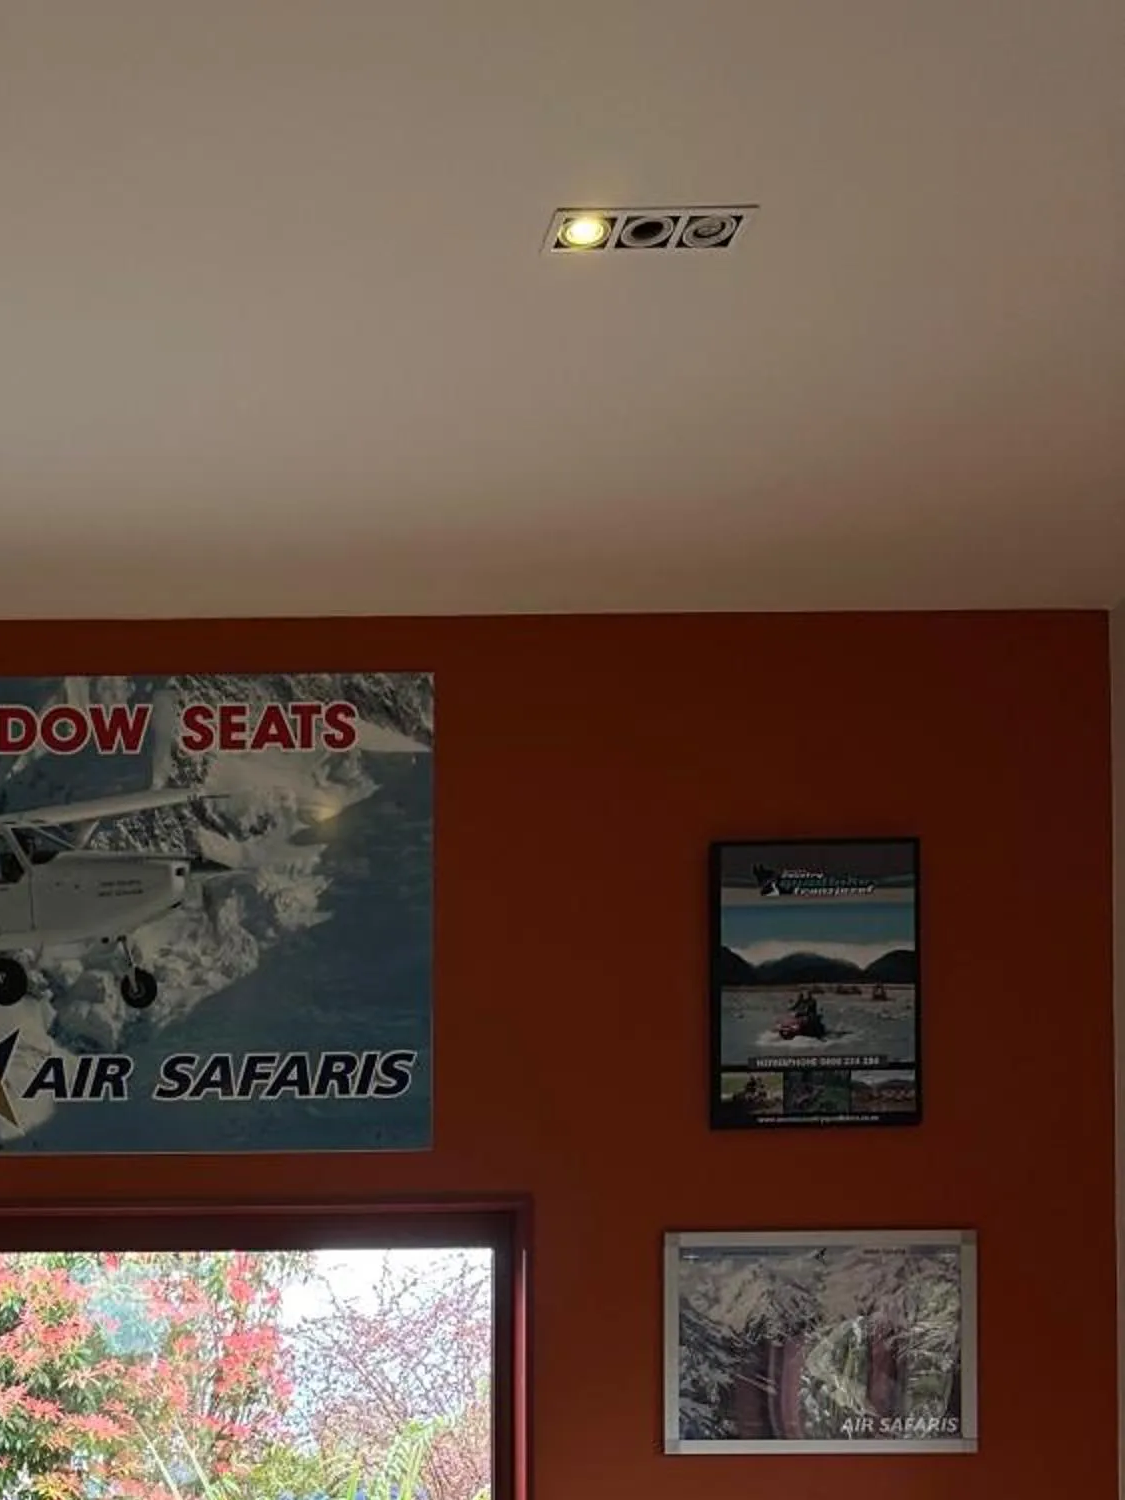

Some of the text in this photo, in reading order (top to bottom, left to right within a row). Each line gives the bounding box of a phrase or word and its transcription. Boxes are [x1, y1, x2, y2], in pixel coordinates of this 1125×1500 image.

[180, 701, 358, 752] SEATS
[22, 1050, 416, 1100] AIR SAFARIS
[840, 1416, 958, 1434] AIR SAFARIS
